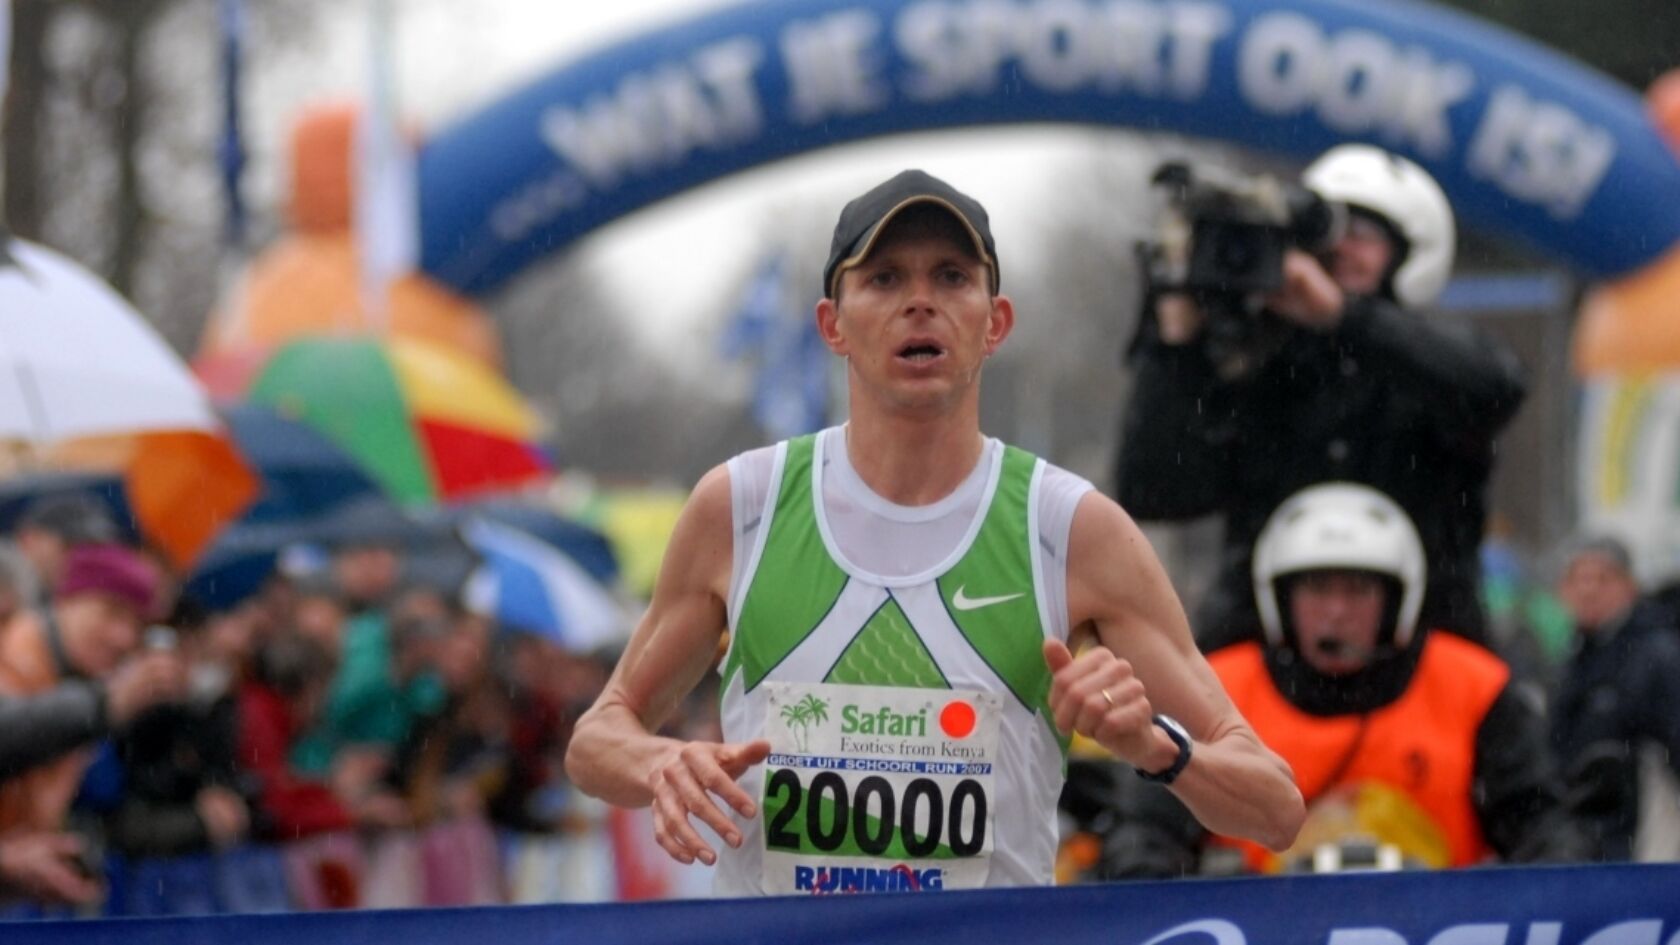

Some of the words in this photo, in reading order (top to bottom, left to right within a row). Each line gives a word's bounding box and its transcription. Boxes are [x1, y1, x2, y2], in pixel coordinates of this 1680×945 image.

[541, 36, 763, 187] WAT
[896, 0, 1231, 99] SPORT
[1237, 11, 1476, 159] OOK
[841, 703, 927, 737] Safari
[840, 736, 896, 753] Exotics
[899, 739, 936, 756] from
[941, 742, 985, 763] Kenya
[769, 755, 814, 769] GROET
[817, 757, 842, 769] UIT
[845, 759, 921, 773] SCHOORL
[925, 763, 958, 774] RUN
[961, 763, 990, 775] 2007
[766, 768, 988, 858] 20000
[795, 865, 943, 892] RUNNING
